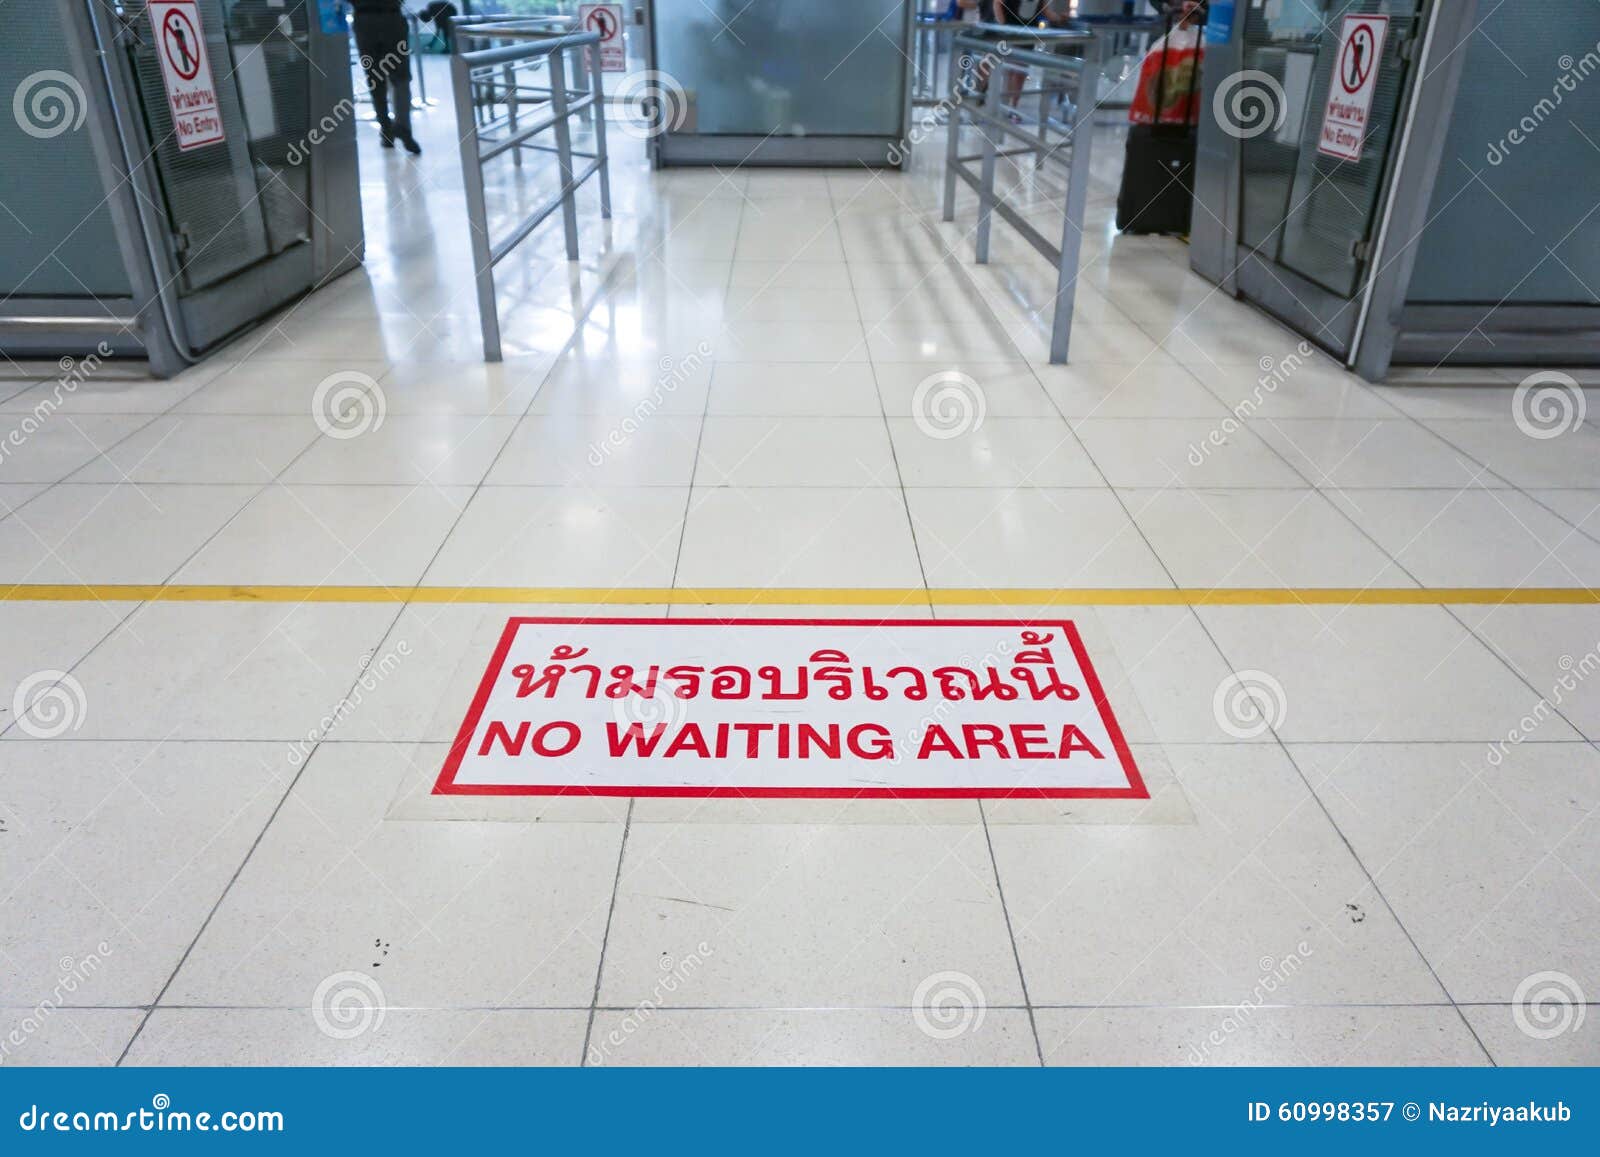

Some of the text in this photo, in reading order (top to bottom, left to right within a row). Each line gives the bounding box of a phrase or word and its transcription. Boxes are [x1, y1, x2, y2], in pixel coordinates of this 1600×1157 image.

[178, 116, 219, 137] No Entry
[1324, 127, 1359, 151] No Entry
[511, 631, 1081, 701] ห้ามรอบริเวณนี้
[477, 720, 1106, 760] NO WAITING AREA
